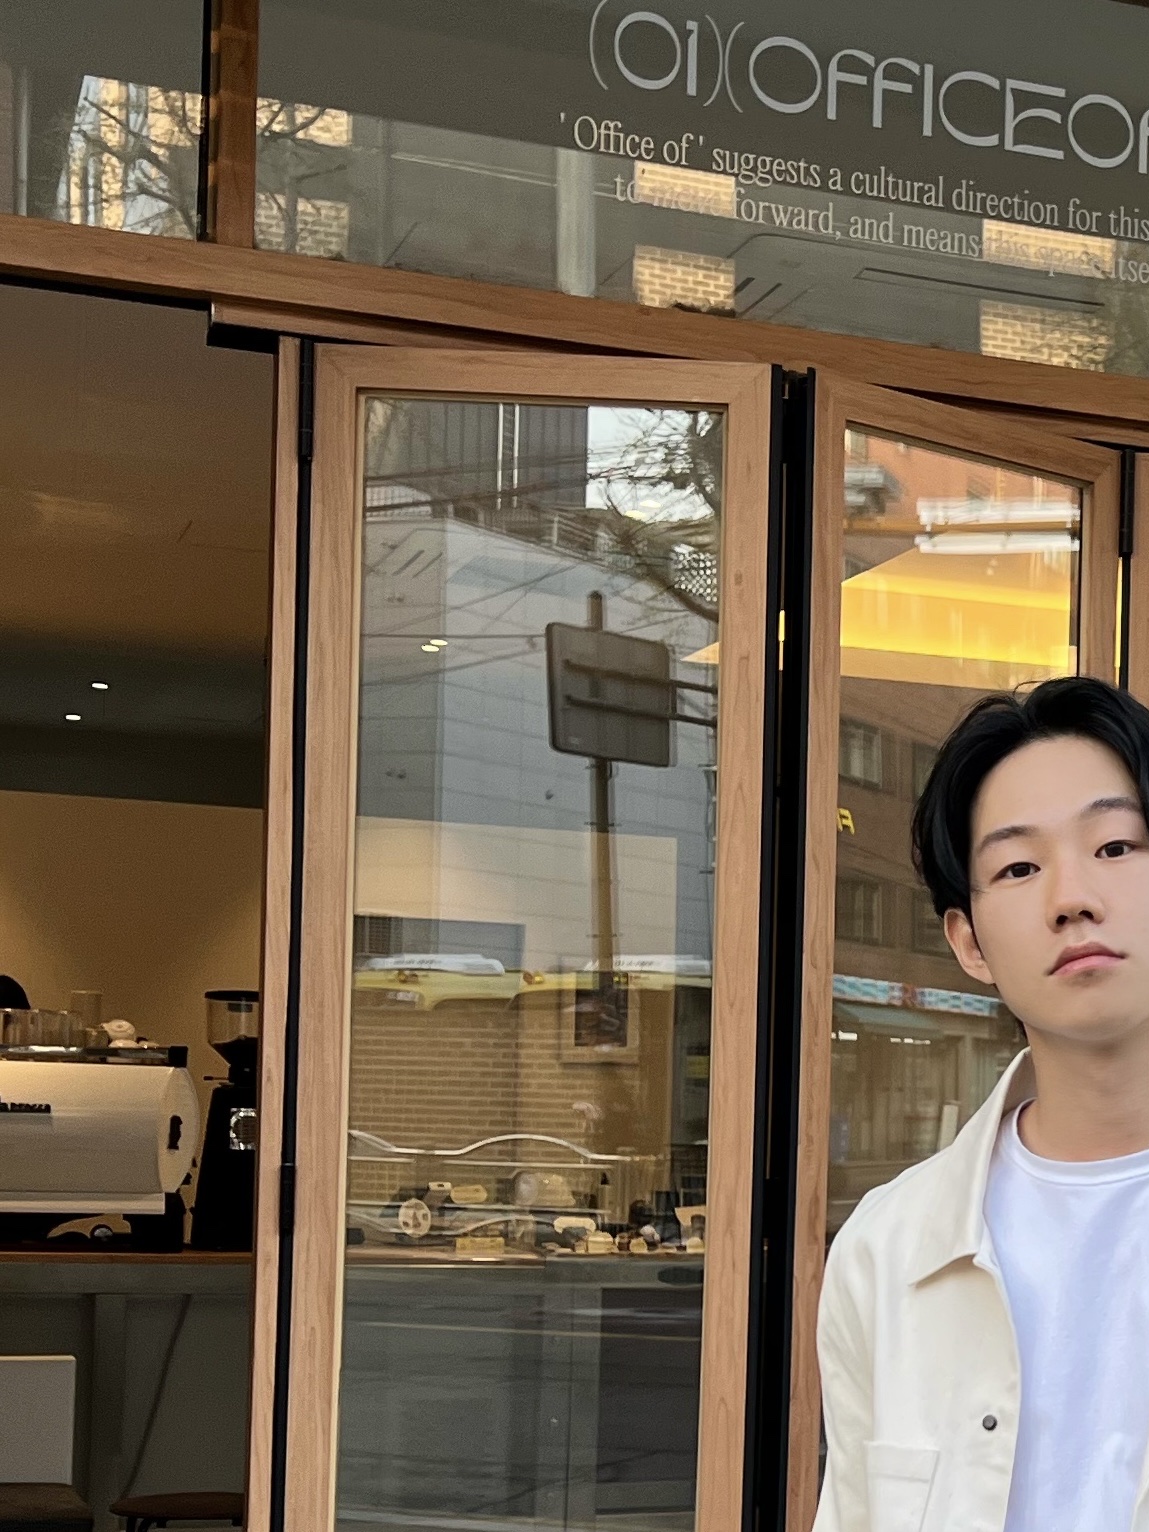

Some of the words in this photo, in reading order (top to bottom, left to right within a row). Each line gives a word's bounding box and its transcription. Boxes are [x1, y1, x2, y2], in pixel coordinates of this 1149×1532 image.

[614, 174, 641, 204] to
[734, 187, 842, 239] forward,
[849, 210, 894, 245] and
[903, 223, 979, 258] means
[712, 146, 821, 188] suggests
[828, 169, 843, 191] a
[850, 166, 944, 208] cultural
[952, 180, 1059, 226] direction
[1068, 199, 1102, 232] for
